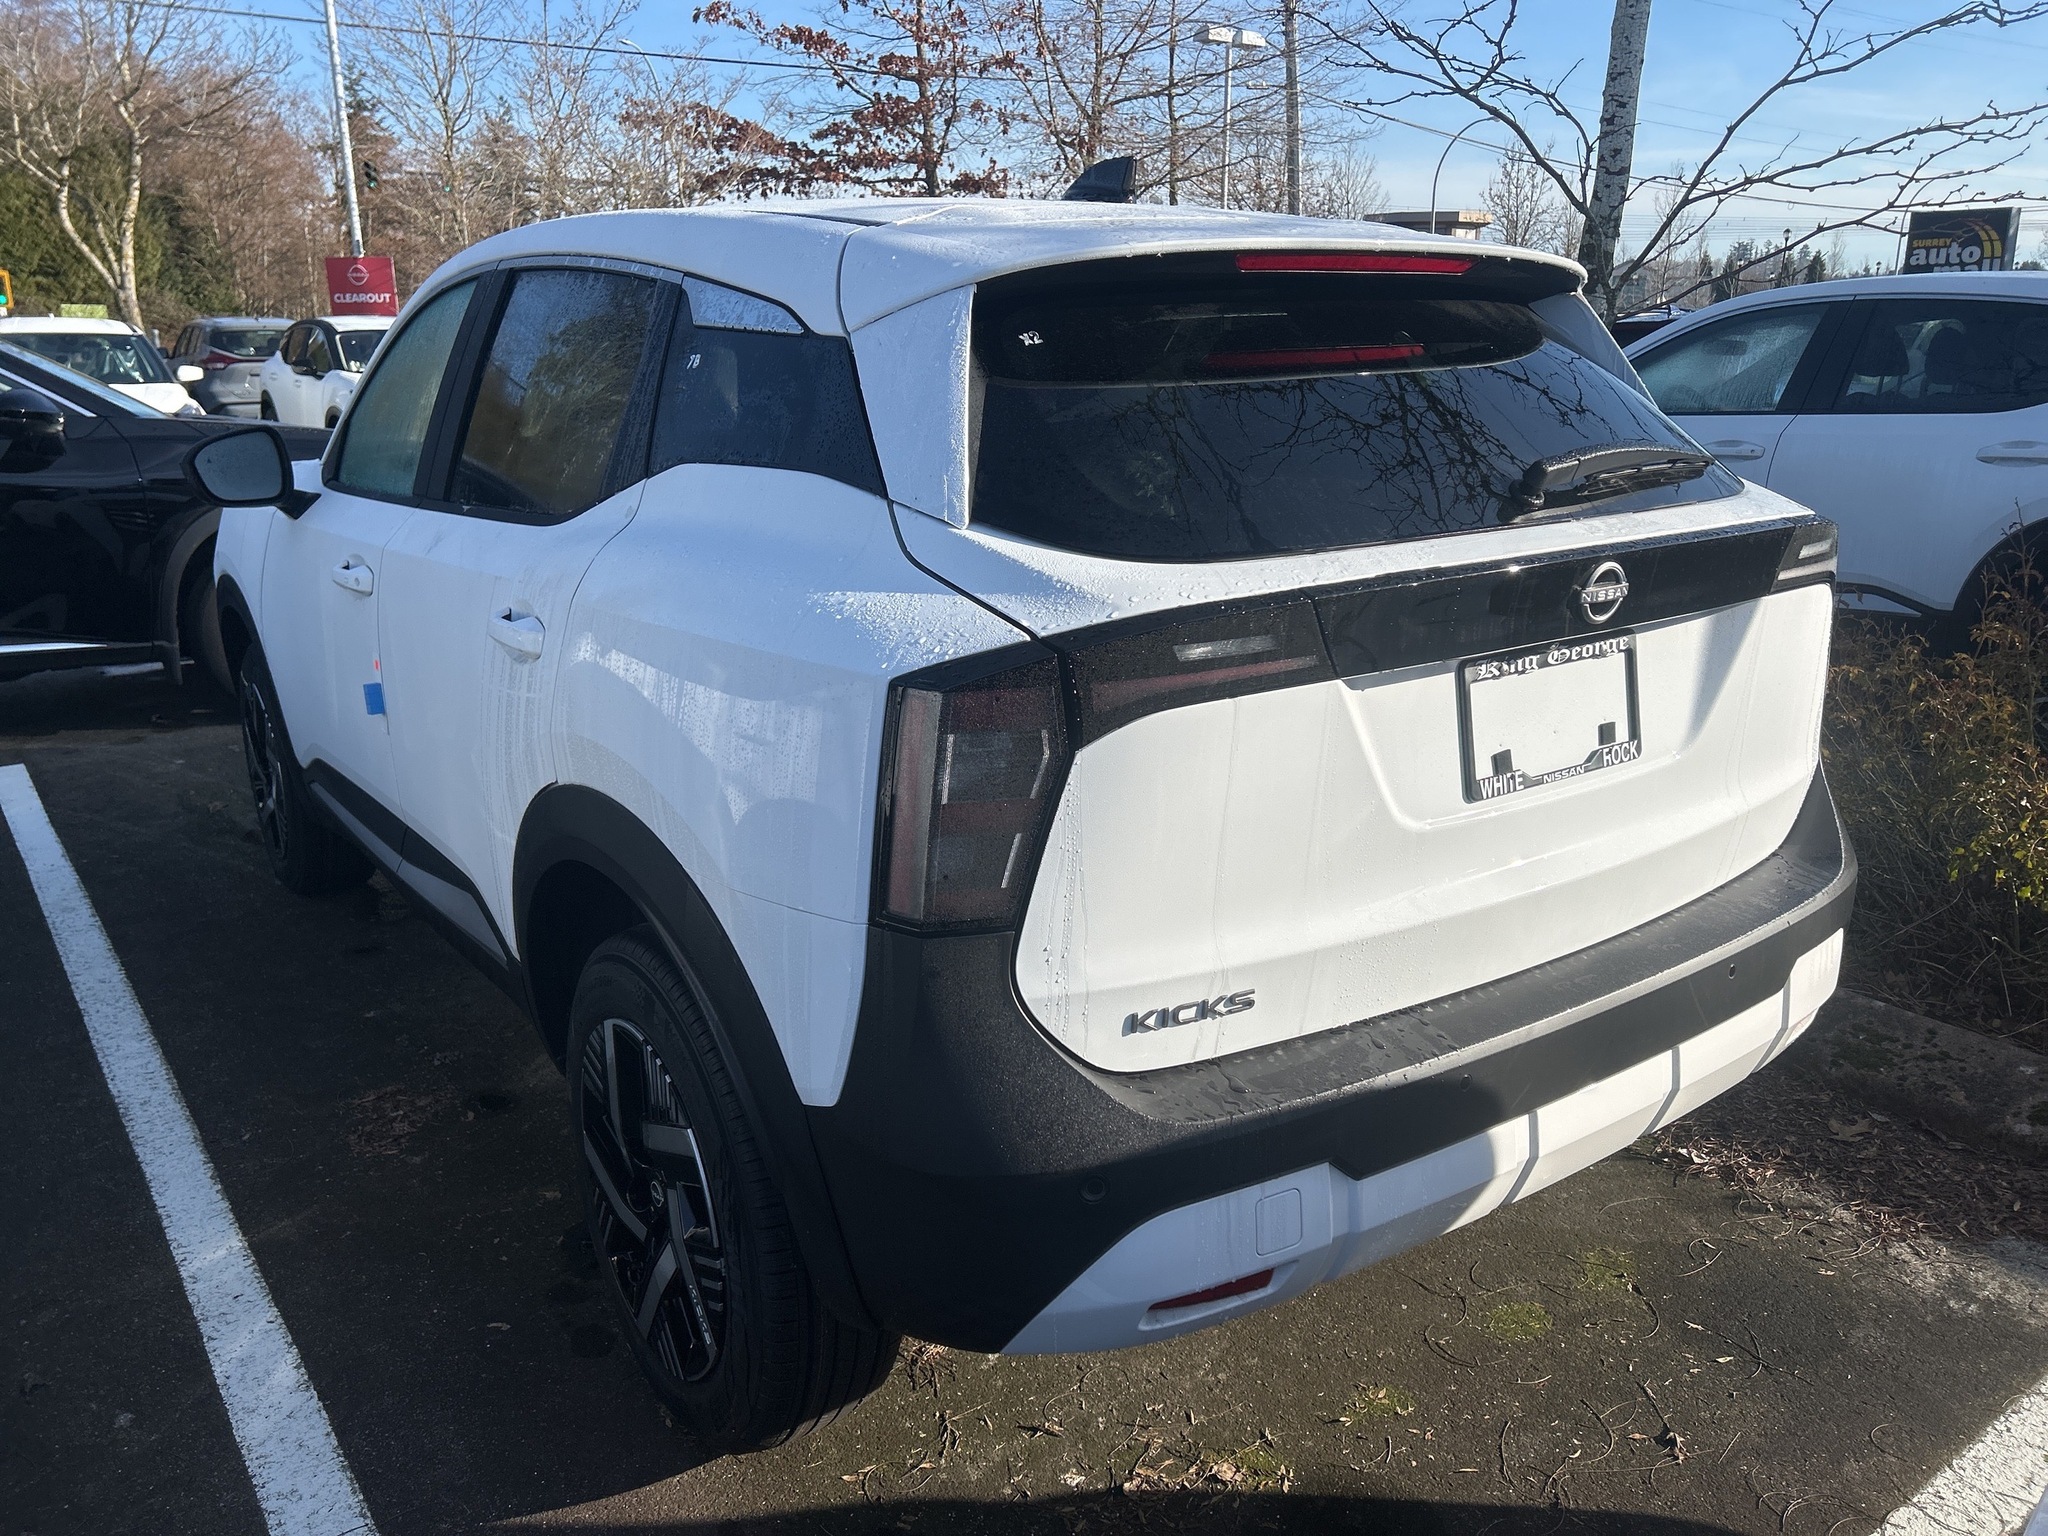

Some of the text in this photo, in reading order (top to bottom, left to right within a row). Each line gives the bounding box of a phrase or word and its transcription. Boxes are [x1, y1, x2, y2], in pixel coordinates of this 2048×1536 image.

[1909, 241, 1982, 266] auto
[1912, 237, 1954, 248] SURREY
[333, 293, 392, 304] CLEAROUT
[1581, 585, 1629, 603] NISSAN
[1547, 635, 1629, 665] George
[1479, 739, 1639, 800] WHITE NISSAN ROCK
[1123, 988, 1256, 1036] KICKS
